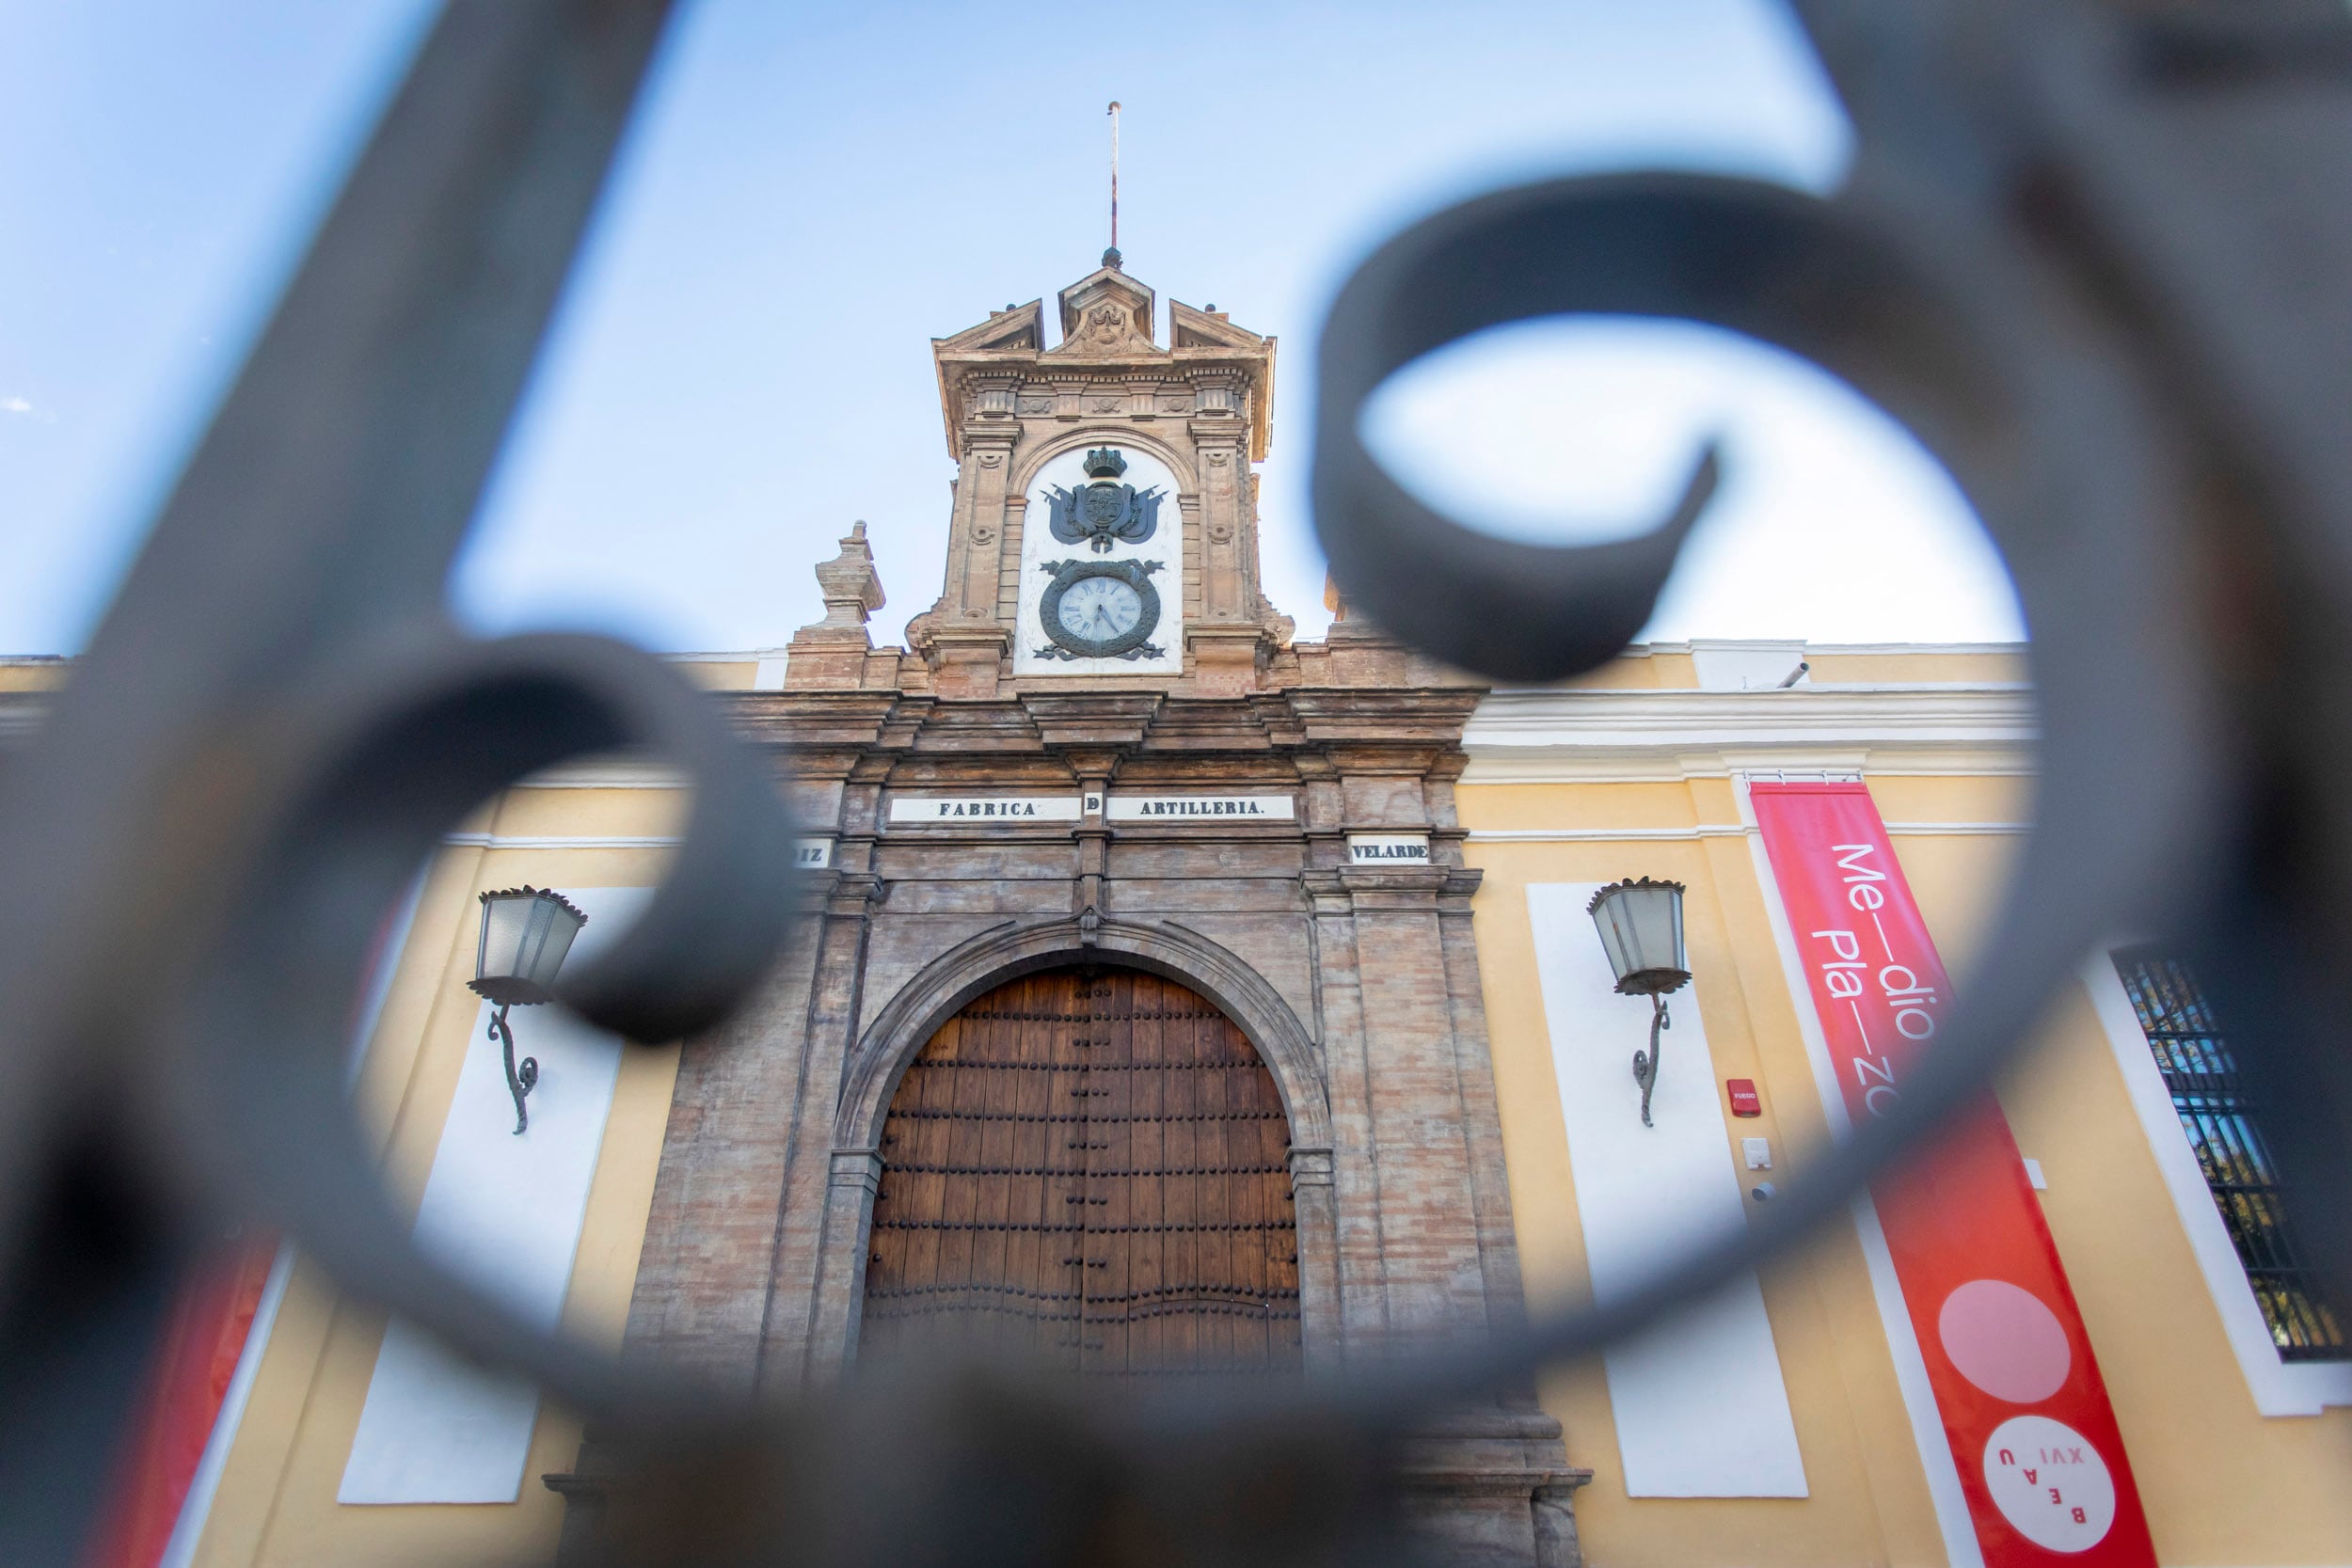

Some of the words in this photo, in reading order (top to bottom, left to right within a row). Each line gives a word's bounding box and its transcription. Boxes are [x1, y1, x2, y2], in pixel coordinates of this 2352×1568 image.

[939, 802, 1035, 816] FABRICA
[1140, 801, 1265, 815] ARTILLERIA.
[1352, 845, 1428, 858] VELARDE
[2039, 1448, 2085, 1464] XVI
